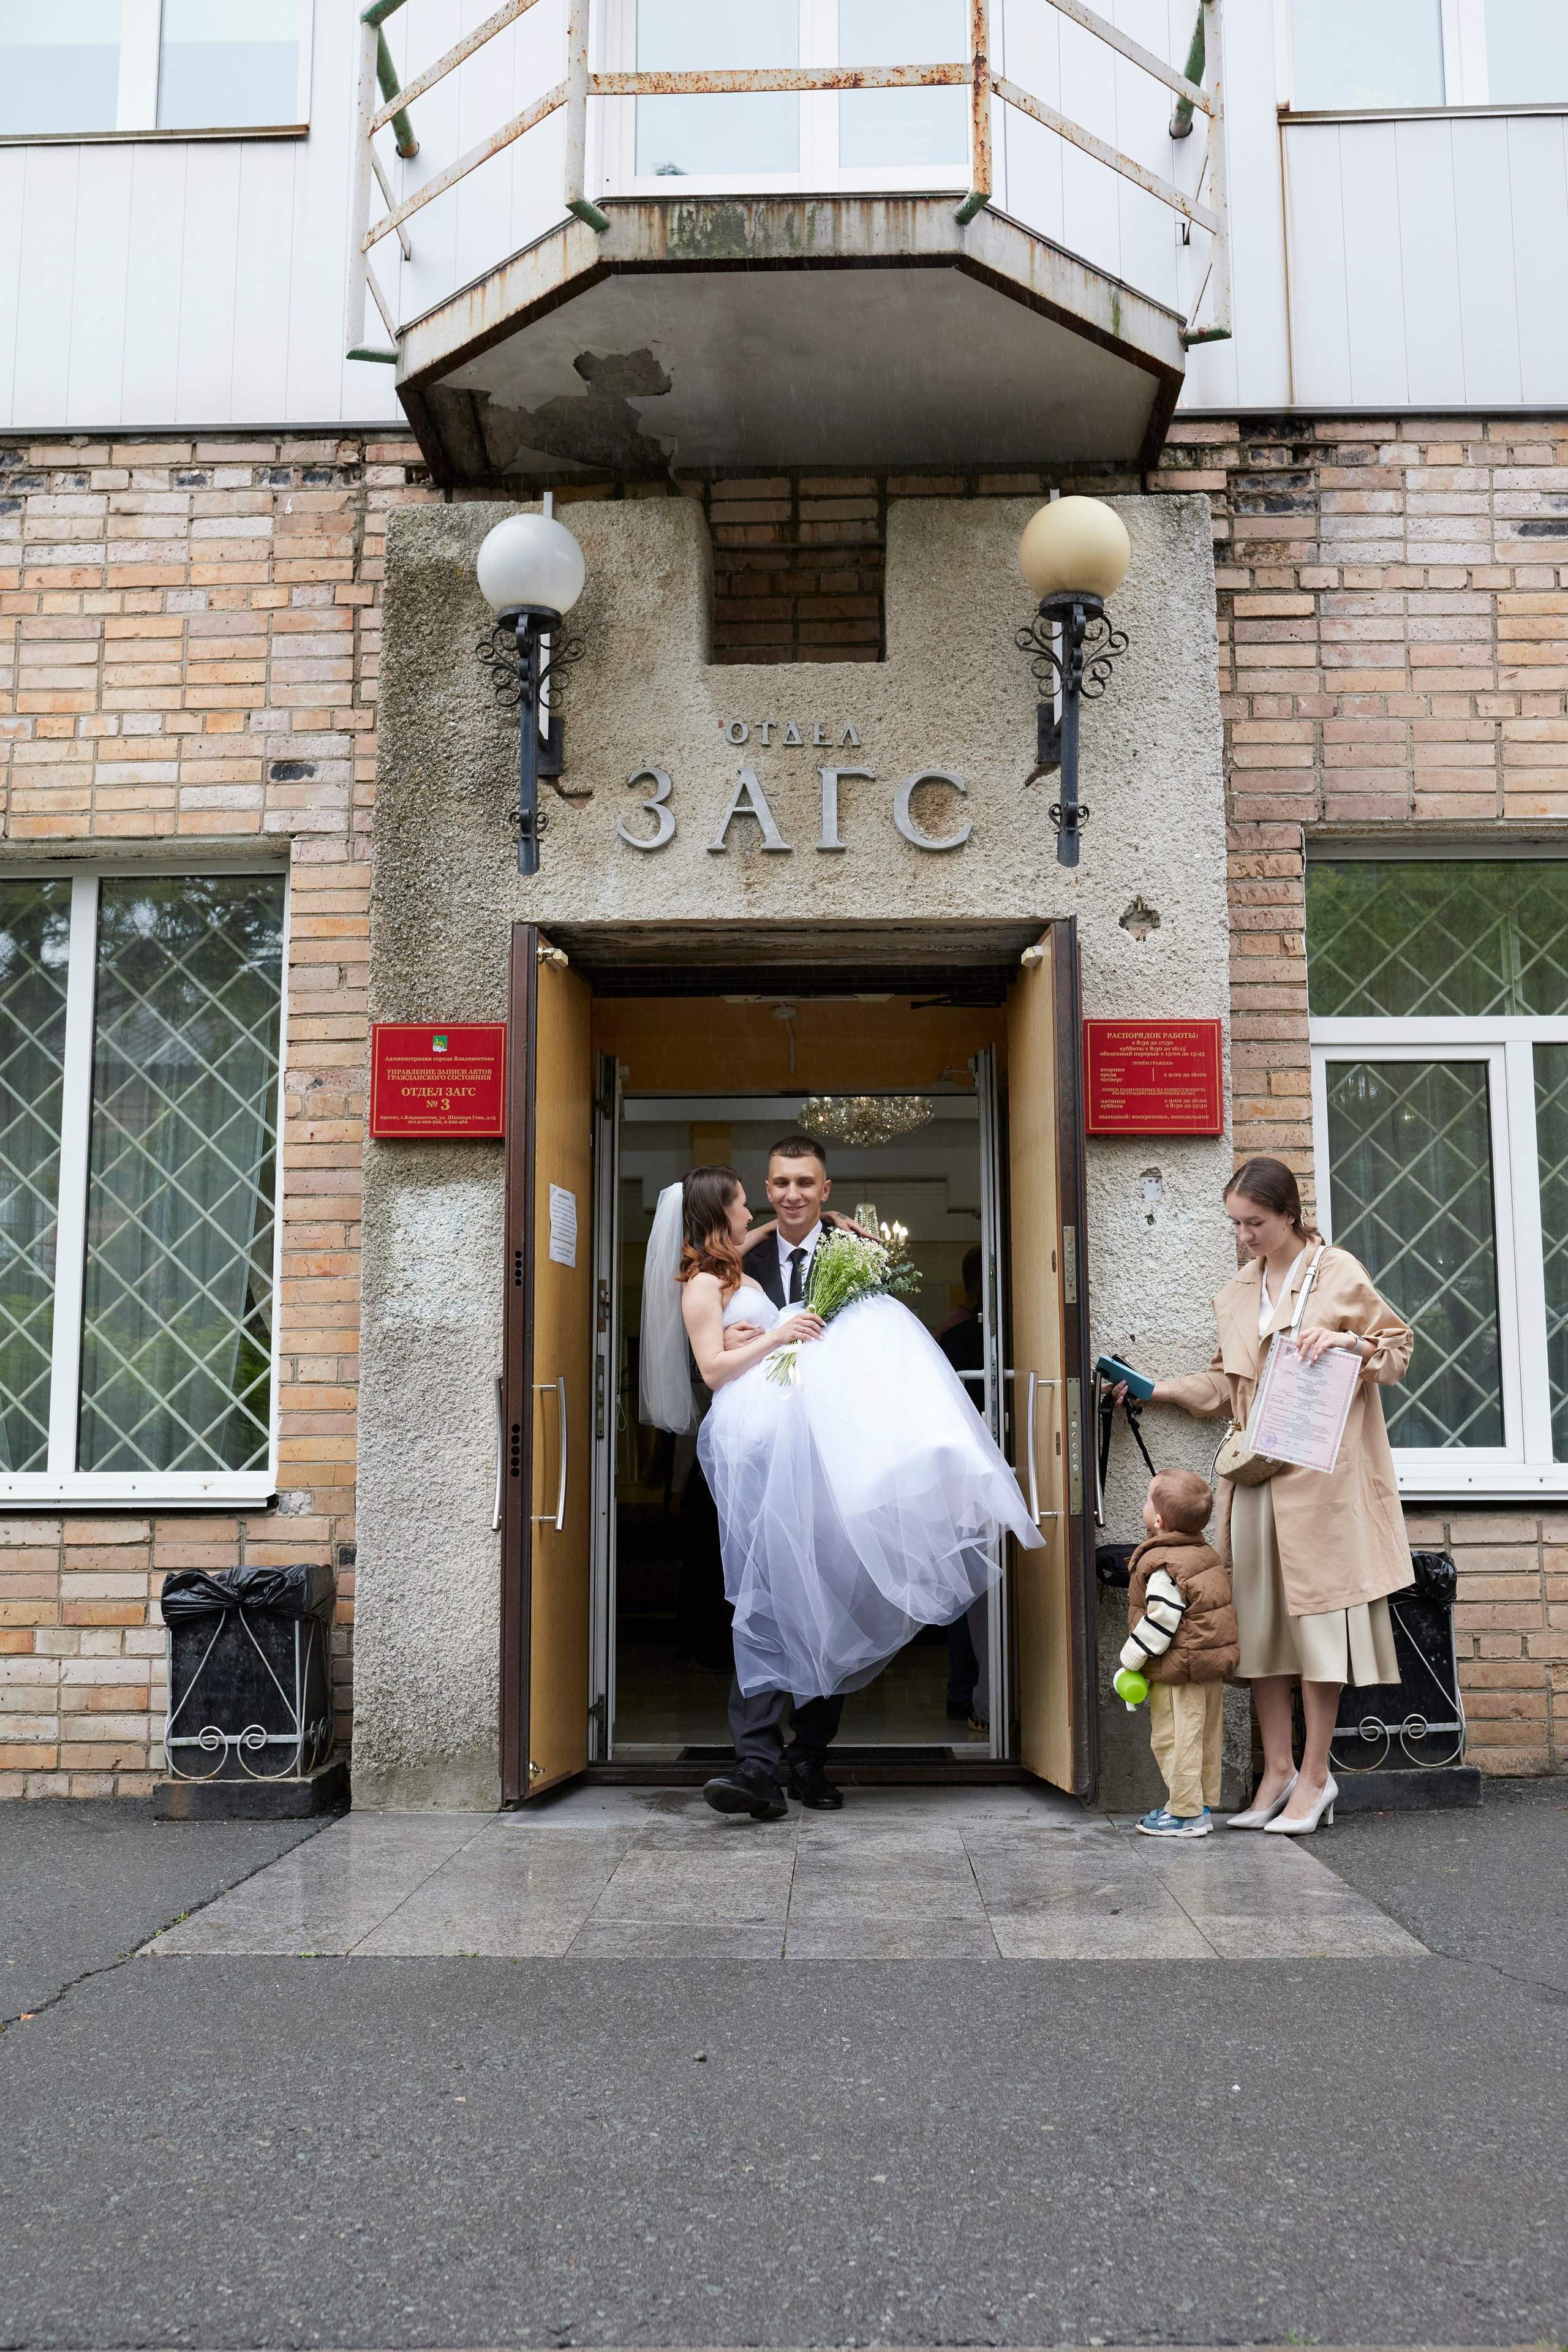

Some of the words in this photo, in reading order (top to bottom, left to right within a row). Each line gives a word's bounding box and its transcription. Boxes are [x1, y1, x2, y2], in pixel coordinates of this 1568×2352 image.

[725, 721, 861, 747] ОТДЕЛ
[617, 766, 973, 852] ЗАГС
[401, 1087, 443, 1097] ОТДЕЛ
[446, 1087, 476, 1096] ЗАГС
[440, 1099, 450, 1110] 3
